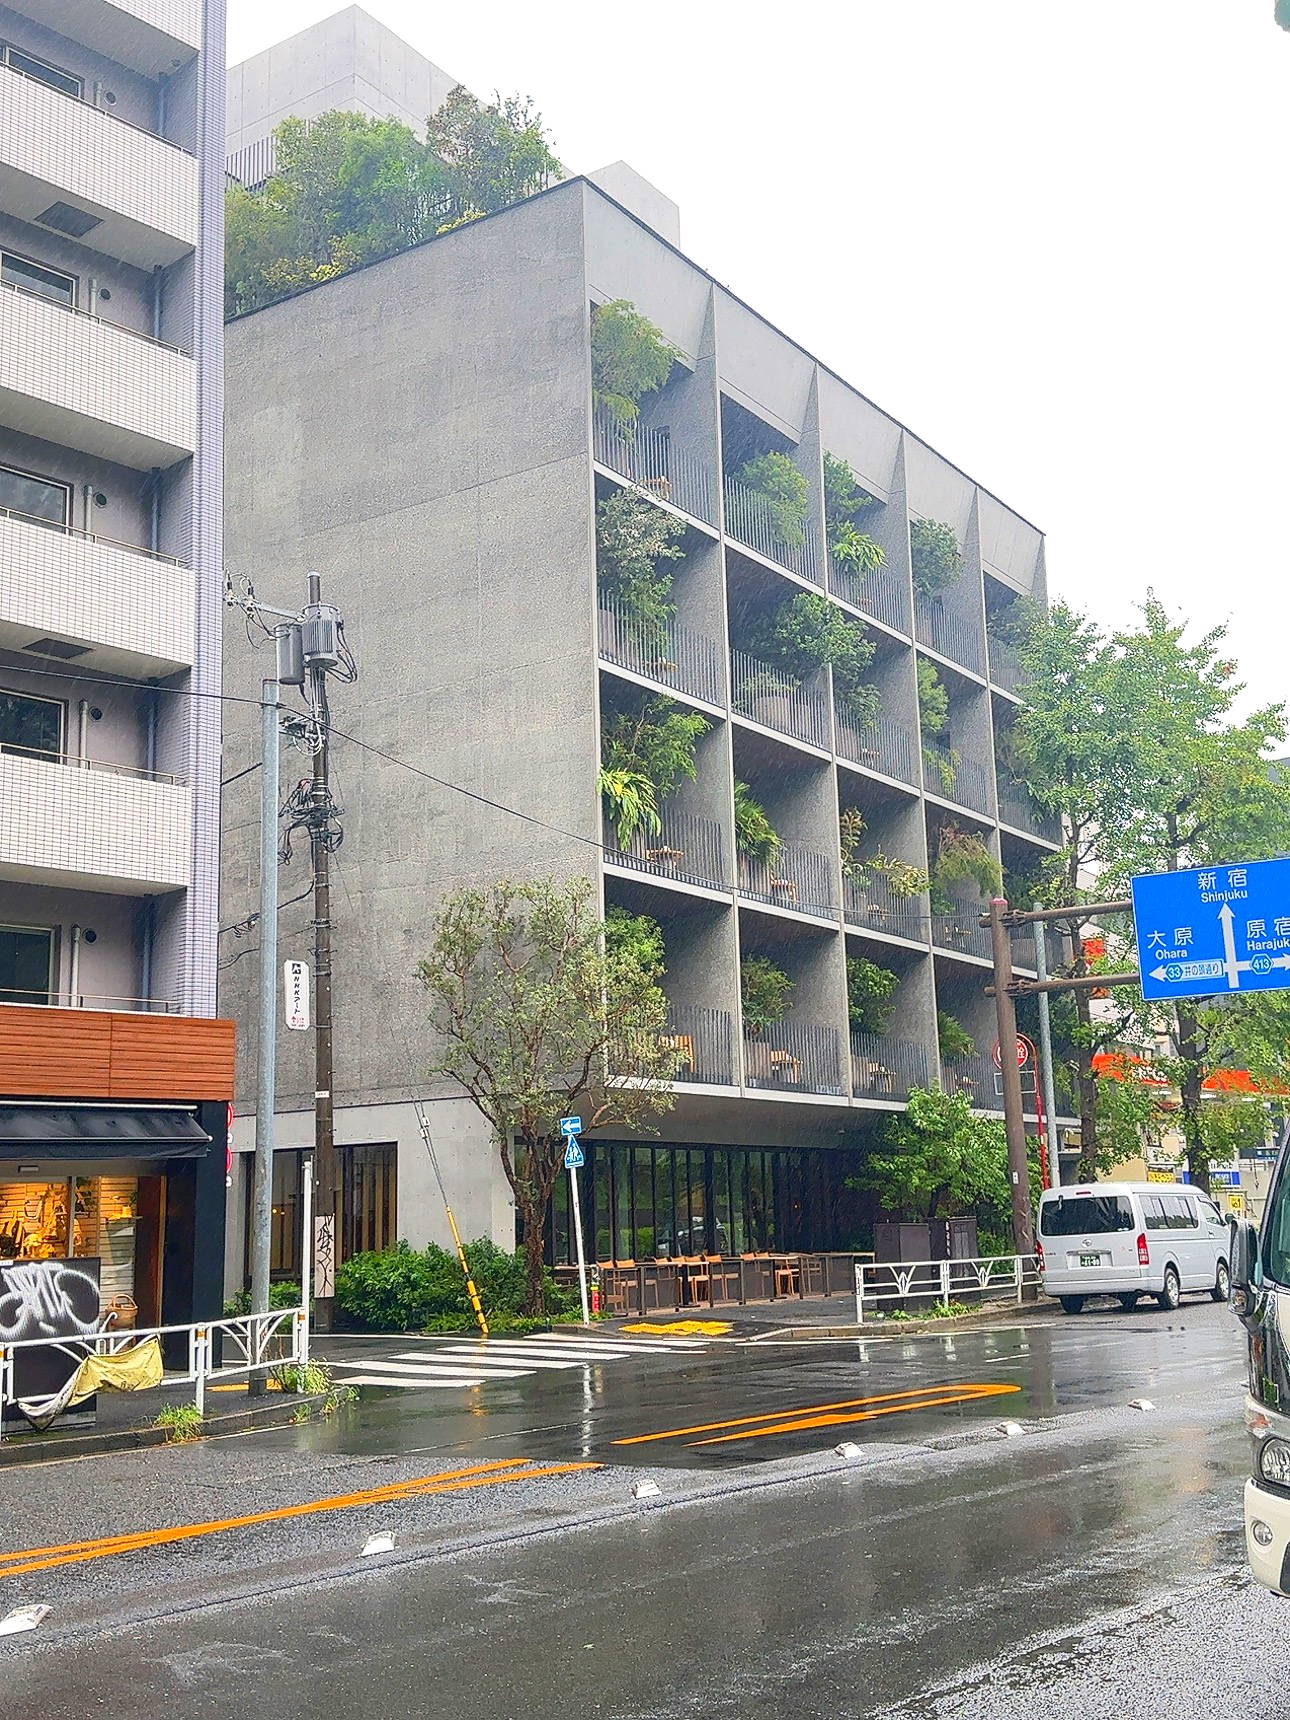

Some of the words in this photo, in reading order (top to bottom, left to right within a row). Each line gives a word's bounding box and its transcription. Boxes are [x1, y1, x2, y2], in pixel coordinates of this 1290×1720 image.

[1197, 868, 1247, 890] 新宿
[1201, 889, 1248, 903] Shinjuku
[1246, 916, 1290, 939] 原宿
[1146, 927, 1194, 949] 大原
[1155, 949, 1188, 960] Ohara
[1253, 958, 1270, 970] 413
[1168, 967, 1180, 978] 33
